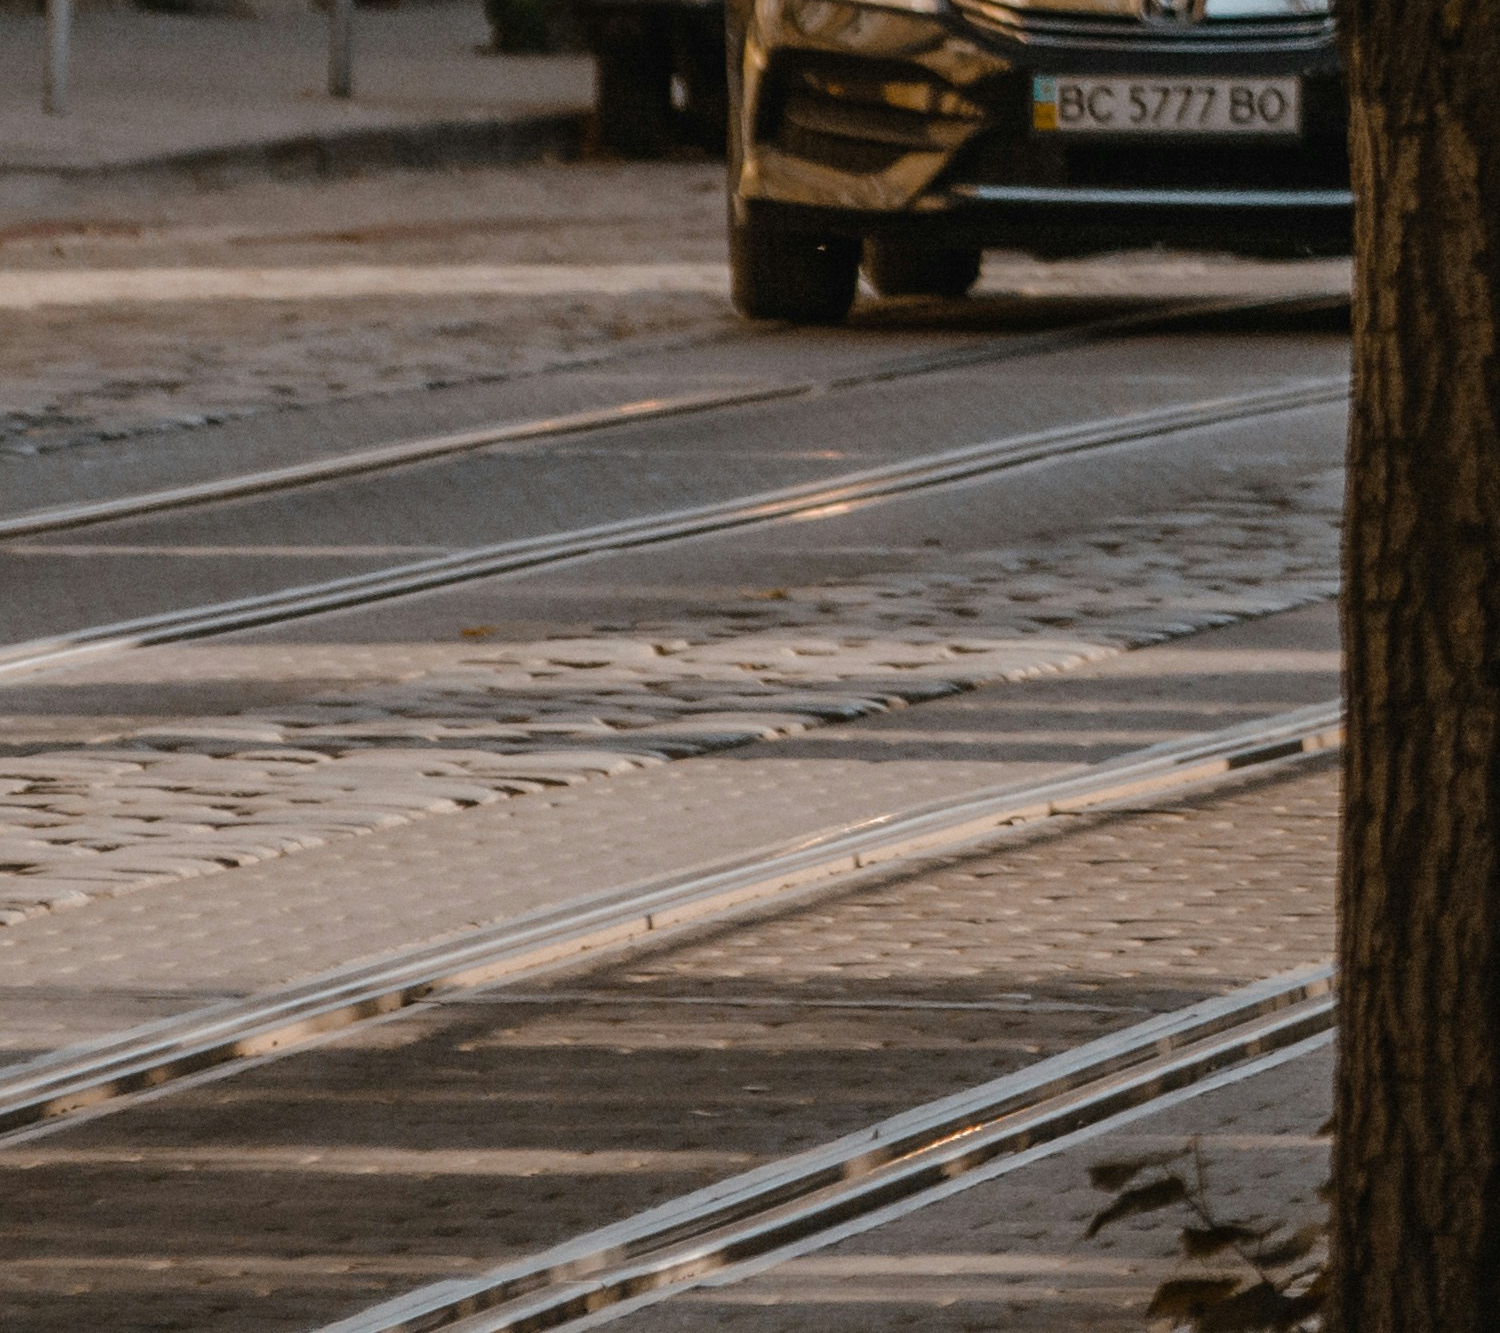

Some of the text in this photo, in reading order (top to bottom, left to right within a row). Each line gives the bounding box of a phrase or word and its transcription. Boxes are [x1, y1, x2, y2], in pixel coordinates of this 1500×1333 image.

[1059, 85, 1115, 124] BC
[1128, 86, 1217, 124] 5777
[1229, 86, 1287, 125] BO
